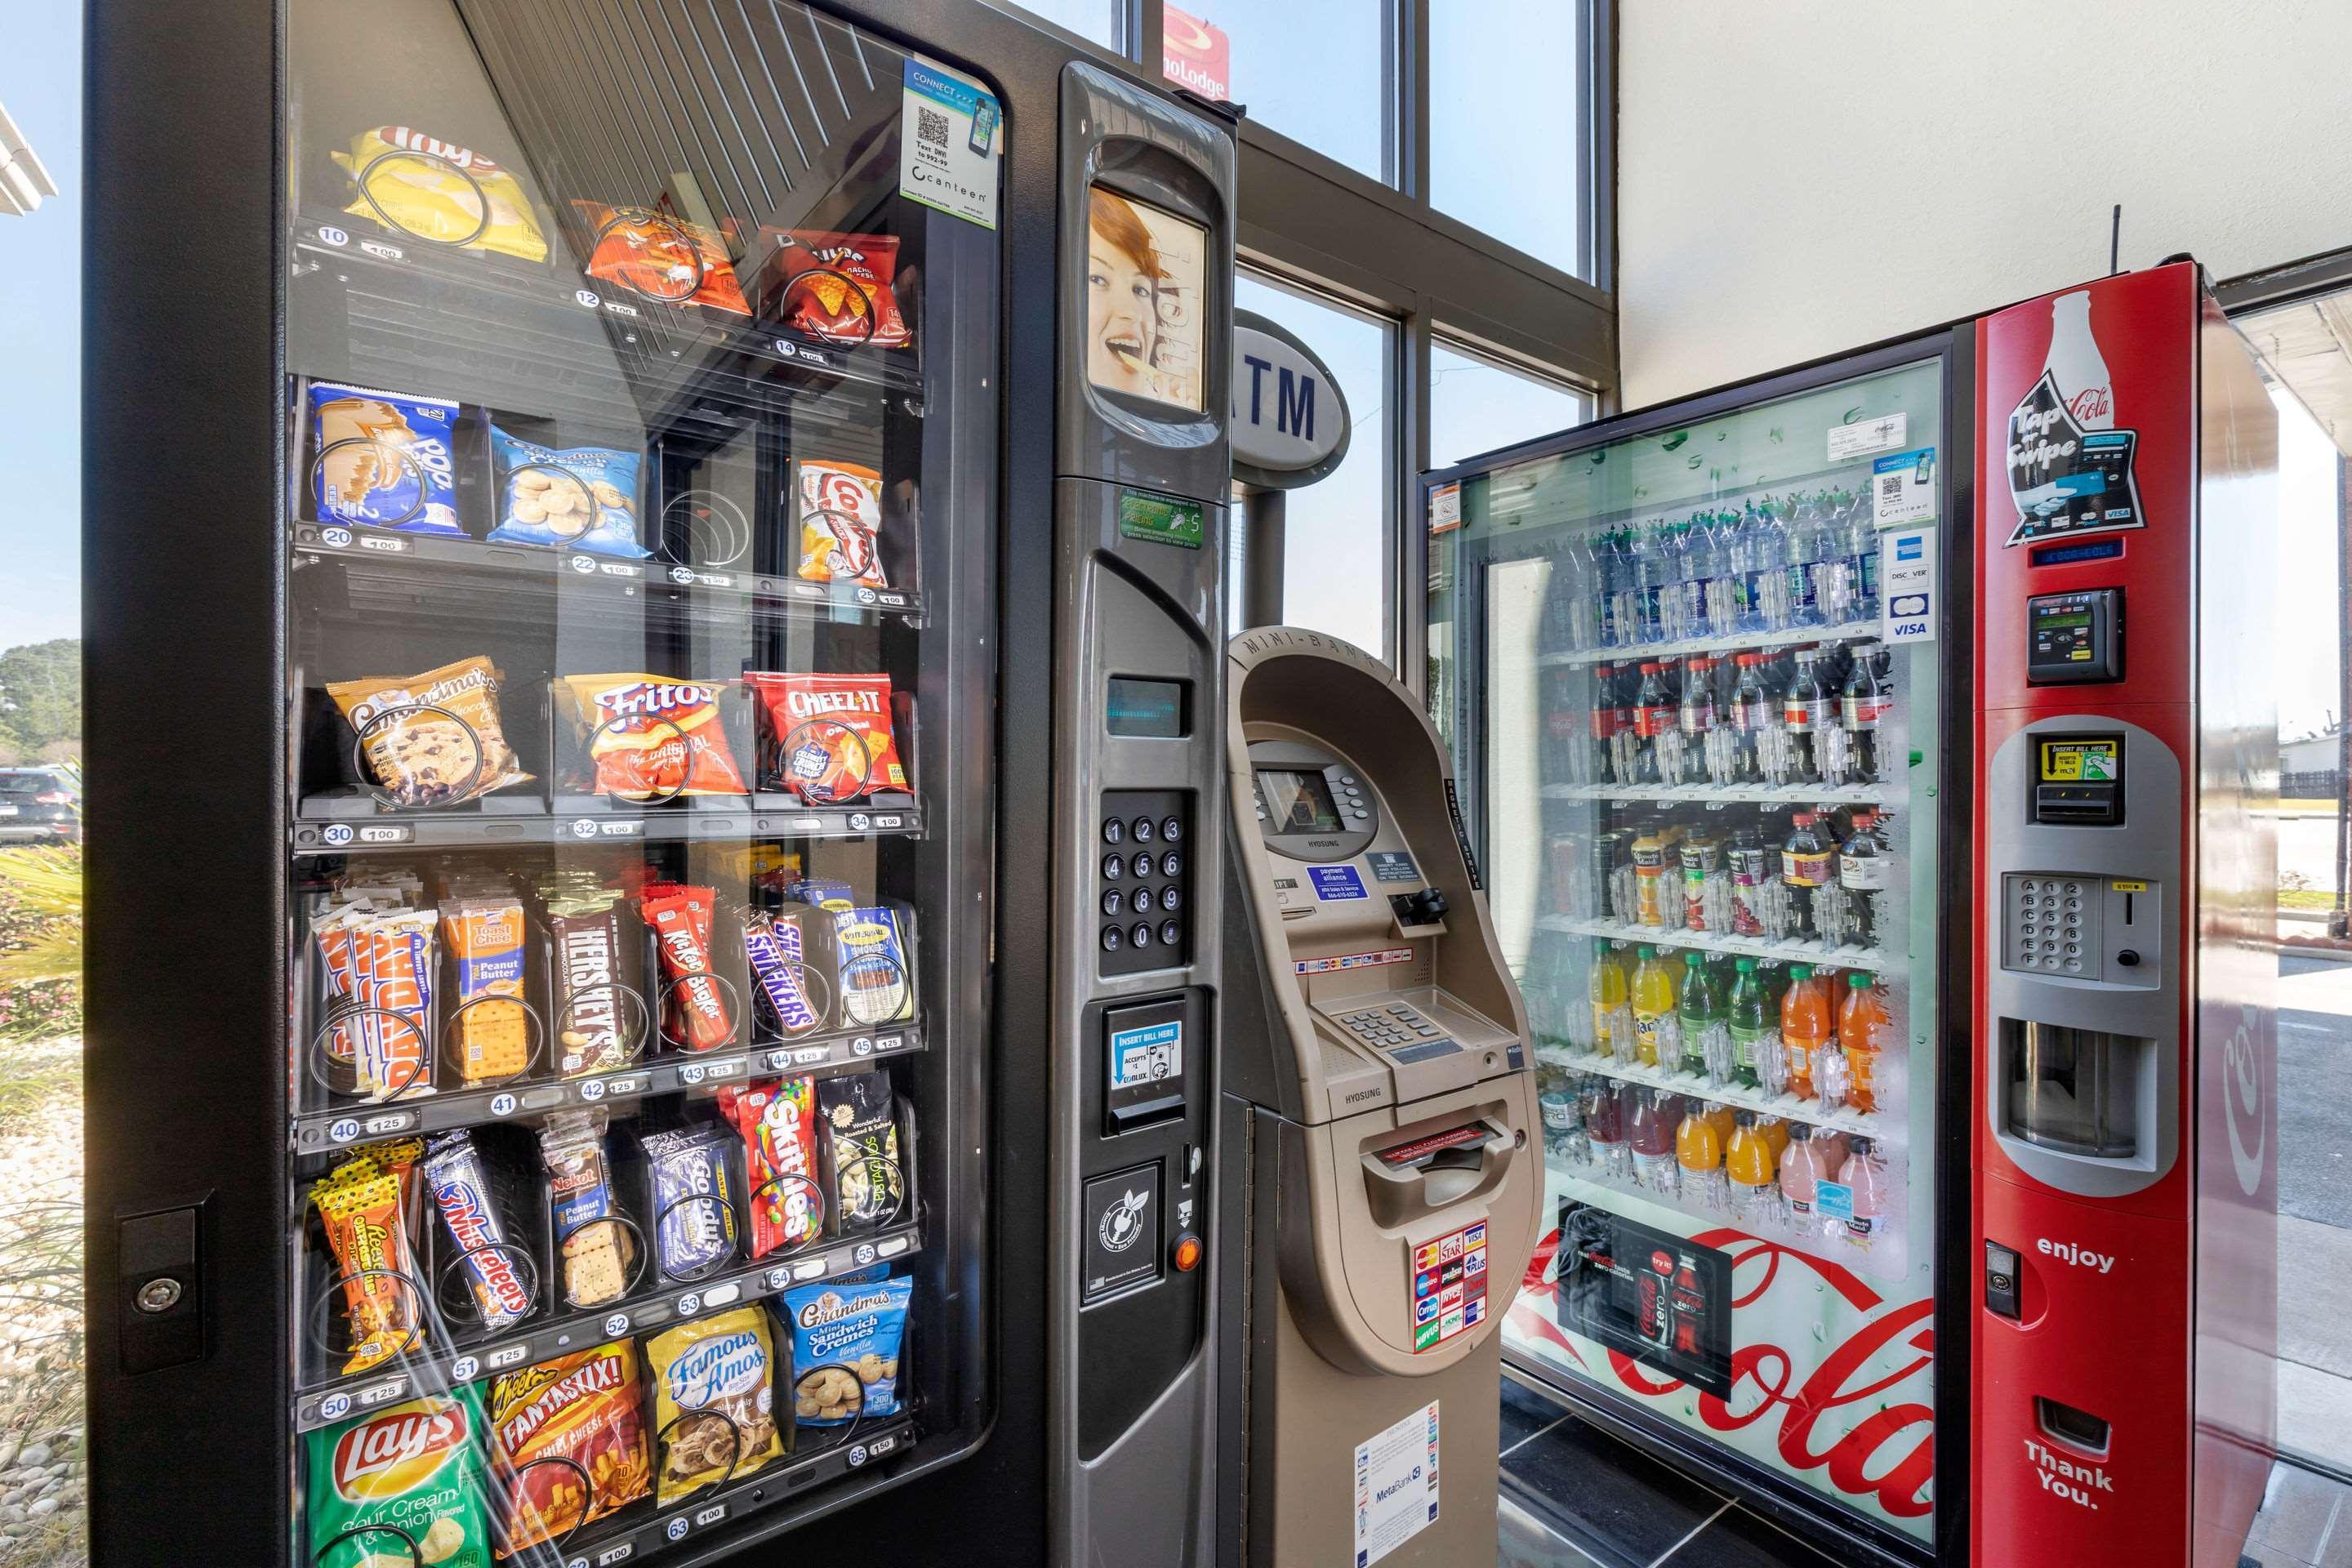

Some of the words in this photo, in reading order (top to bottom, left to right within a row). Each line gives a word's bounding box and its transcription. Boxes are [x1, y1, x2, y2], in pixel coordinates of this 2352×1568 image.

[913, 72, 956, 95] CONNECT
[322, 229, 346, 243] 10
[579, 291, 598, 305] 12
[777, 341, 794, 353] 14
[2074, 386, 2109, 421] Cola
[2017, 405, 2062, 434] Tap
[2008, 439, 2077, 470] Swipe
[2108, 509, 2130, 518] VISA
[327, 531, 350, 543] 20
[575, 558, 594, 569] 22
[860, 590, 875, 600] 25
[1895, 622, 1927, 636] VISA
[594, 683, 714, 733] Fritos
[788, 691, 881, 718] CHEEZ-IT
[575, 822, 595, 834] 32
[853, 817, 867, 827] 34
[327, 829, 351, 841] 30
[1112, 824, 1118, 840] 1
[1142, 823, 1149, 838] 2
[1169, 822, 1178, 838] 3
[1447, 780, 1464, 837] MAGNETIC
[1463, 845, 1480, 889] STRIPE
[1307, 840, 1339, 849] HYOSUNG
[1111, 859, 1119, 875] 4
[1140, 858, 1148, 873] 5
[1168, 857, 1177, 872] 6
[1111, 895, 1120, 911] 7
[1140, 893, 1148, 908] 8
[1168, 891, 1176, 906] 9
[474, 923, 511, 936] Toast
[1138, 928, 1147, 943] 0
[2069, 930, 2076, 938] 8
[413, 939, 421, 948] BAR
[474, 933, 510, 946] Chee
[414, 947, 424, 969] CARAMEL
[663, 930, 704, 973] KitKat
[480, 960, 518, 971] Peanut
[480, 969, 515, 979] Butter
[416, 969, 426, 994] PEANUT
[568, 930, 614, 1049] HERSHEY'S
[746, 934, 815, 1028] SNICKERS
[687, 976, 721, 1020] BigKat
[372, 931, 431, 1089] PAYDAY
[1120, 1035, 1143, 1046] INSERT
[1143, 1032, 1156, 1041] BILL
[1158, 1028, 1174, 1039] HERE
[855, 1040, 870, 1052] 45
[773, 1054, 790, 1065] 44
[1125, 1054, 1147, 1064] ACCEPTS
[685, 1067, 702, 1080] 43
[1123, 1072, 1147, 1083] CONLUX
[583, 1084, 603, 1097] 42
[1345, 1087, 1381, 1105] HYOSUNG
[493, 1096, 512, 1111] 41
[334, 1124, 357, 1137] 40
[844, 1129, 867, 1138] Roasted
[874, 1120, 893, 1132] Salted
[852, 1116, 882, 1129] Wonderful
[764, 1100, 808, 1238] Skittles
[866, 1136, 884, 1201] PISTACHIOS
[552, 1169, 595, 1193] Nekot
[436, 1186, 461, 1206] 3
[717, 1172, 725, 1192] FAST
[724, 1210, 733, 1236] RELIEF
[565, 1200, 599, 1215] Peanut
[696, 1158, 724, 1254] Goody's
[567, 1209, 598, 1224] Butter
[1468, 1232, 1481, 1244] VISA
[444, 1205, 529, 1316] Musketeers
[859, 1247, 874, 1260] 55
[1441, 1245, 1461, 1261] STAR
[2037, 1238, 2115, 1274] enjoy
[1470, 1258, 1486, 1274] PLUS
[1577, 1250, 1589, 1259] real
[1615, 1263, 1632, 1275] taste
[1652, 1256, 1664, 1267] try
[1664, 1259, 1673, 1270] it!
[773, 1272, 788, 1285] 54
[1441, 1265, 1463, 1284] pulse
[1594, 1262, 1609, 1272] zero
[1609, 1268, 1634, 1282] calories
[1419, 1277, 1437, 1290] Maestro
[1441, 1287, 1463, 1302] NYCE
[680, 1297, 698, 1312] 53
[798, 1291, 890, 1330] Grandma's
[1418, 1303, 1438, 1316] Cirrus
[1640, 1272, 1657, 1337] Coca-Cola
[1656, 1294, 1666, 1329] zero
[1677, 1299, 1697, 1312] zero
[607, 1318, 626, 1334] 52
[808, 1314, 879, 1346] Sandwich
[817, 1322, 842, 1337] Mini
[812, 1326, 875, 1357] Cremes
[1416, 1322, 1439, 1348] NOVUS
[839, 1339, 872, 1357] Vanilla
[456, 1360, 475, 1378] 51
[668, 1331, 758, 1401] Famous
[696, 1348, 767, 1408] Amos
[325, 1398, 349, 1415] 50
[502, 1356, 621, 1452] FANTASTIX!
[569, 1414, 604, 1446] CHEESE
[850, 1449, 866, 1463] 65
[2024, 1439, 2114, 1493] Thank
[1376, 1472, 1413, 1504] MetaBank
[2036, 1468, 2098, 1510] You.
[341, 1508, 386, 1532] Sour
[392, 1488, 457, 1517] Cream
[437, 1505, 466, 1519] Flavored
[670, 1521, 687, 1537] 63
